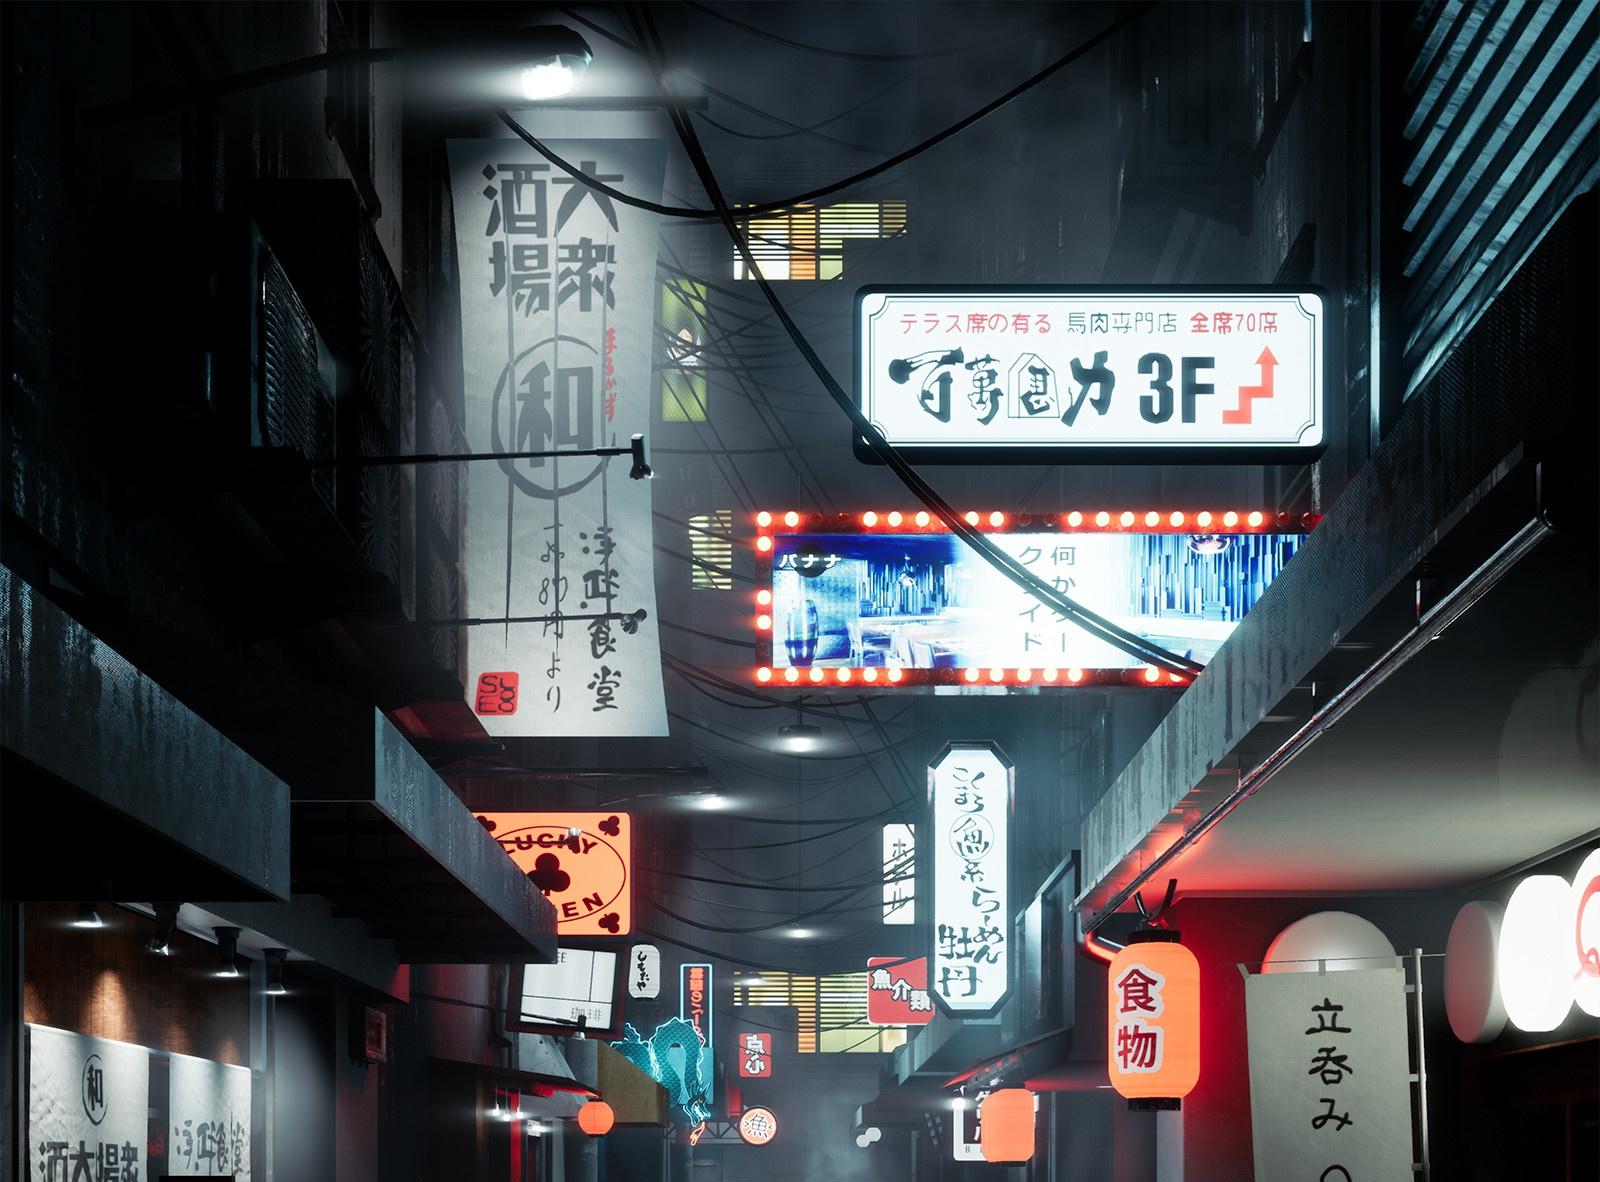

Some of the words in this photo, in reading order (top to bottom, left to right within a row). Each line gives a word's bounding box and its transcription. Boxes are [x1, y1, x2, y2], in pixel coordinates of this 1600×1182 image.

[900, 312, 1052, 335] テラス席の有る
[1067, 311, 1178, 335] 馬肉専門店
[1189, 311, 1279, 335] 全席70席
[1137, 352, 1216, 424] 3F
[1018, 546, 1043, 653] クイド
[1050, 546, 1077, 653] 何かー
[871, 968, 931, 1011] 魚介類
[1117, 968, 1159, 1070] 食物
